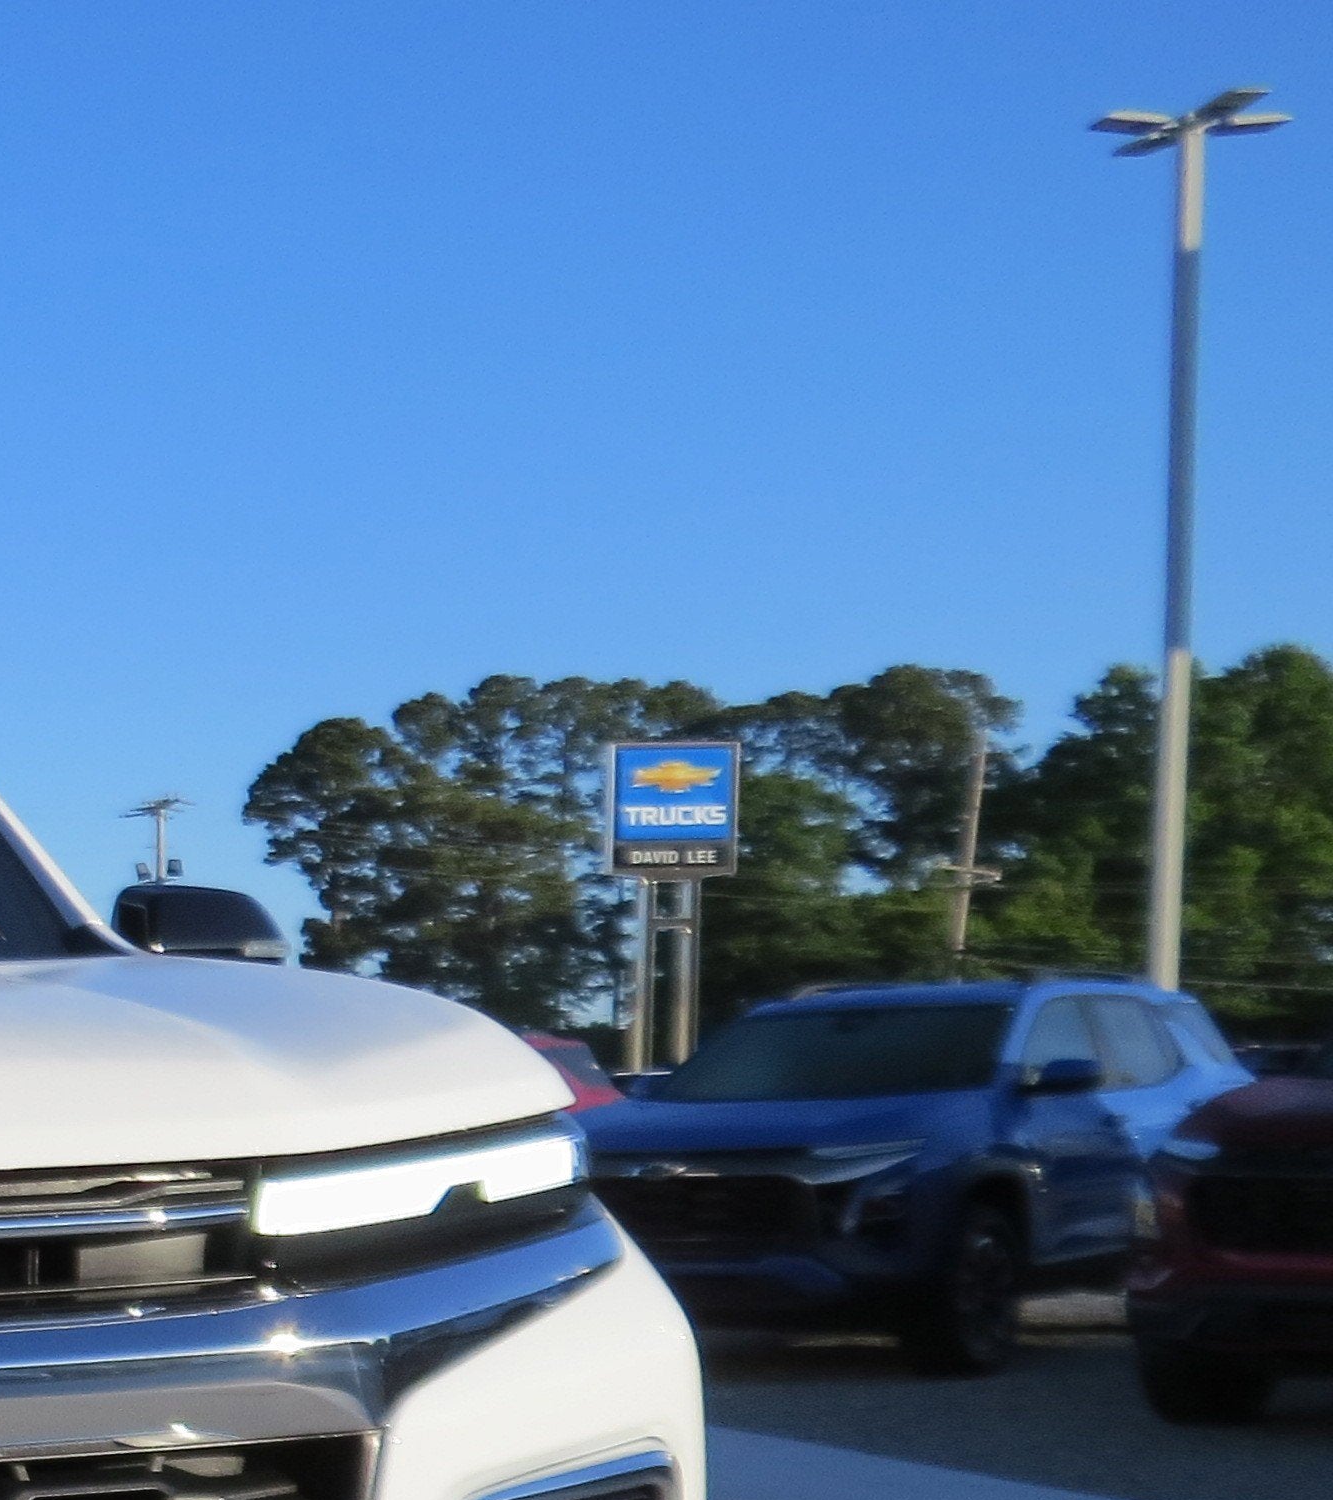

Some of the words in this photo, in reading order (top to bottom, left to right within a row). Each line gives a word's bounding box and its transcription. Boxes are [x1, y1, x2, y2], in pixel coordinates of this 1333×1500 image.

[624, 805, 726, 825] TRUCKS
[631, 850, 679, 864] DAVID
[687, 850, 717, 864] LEE
